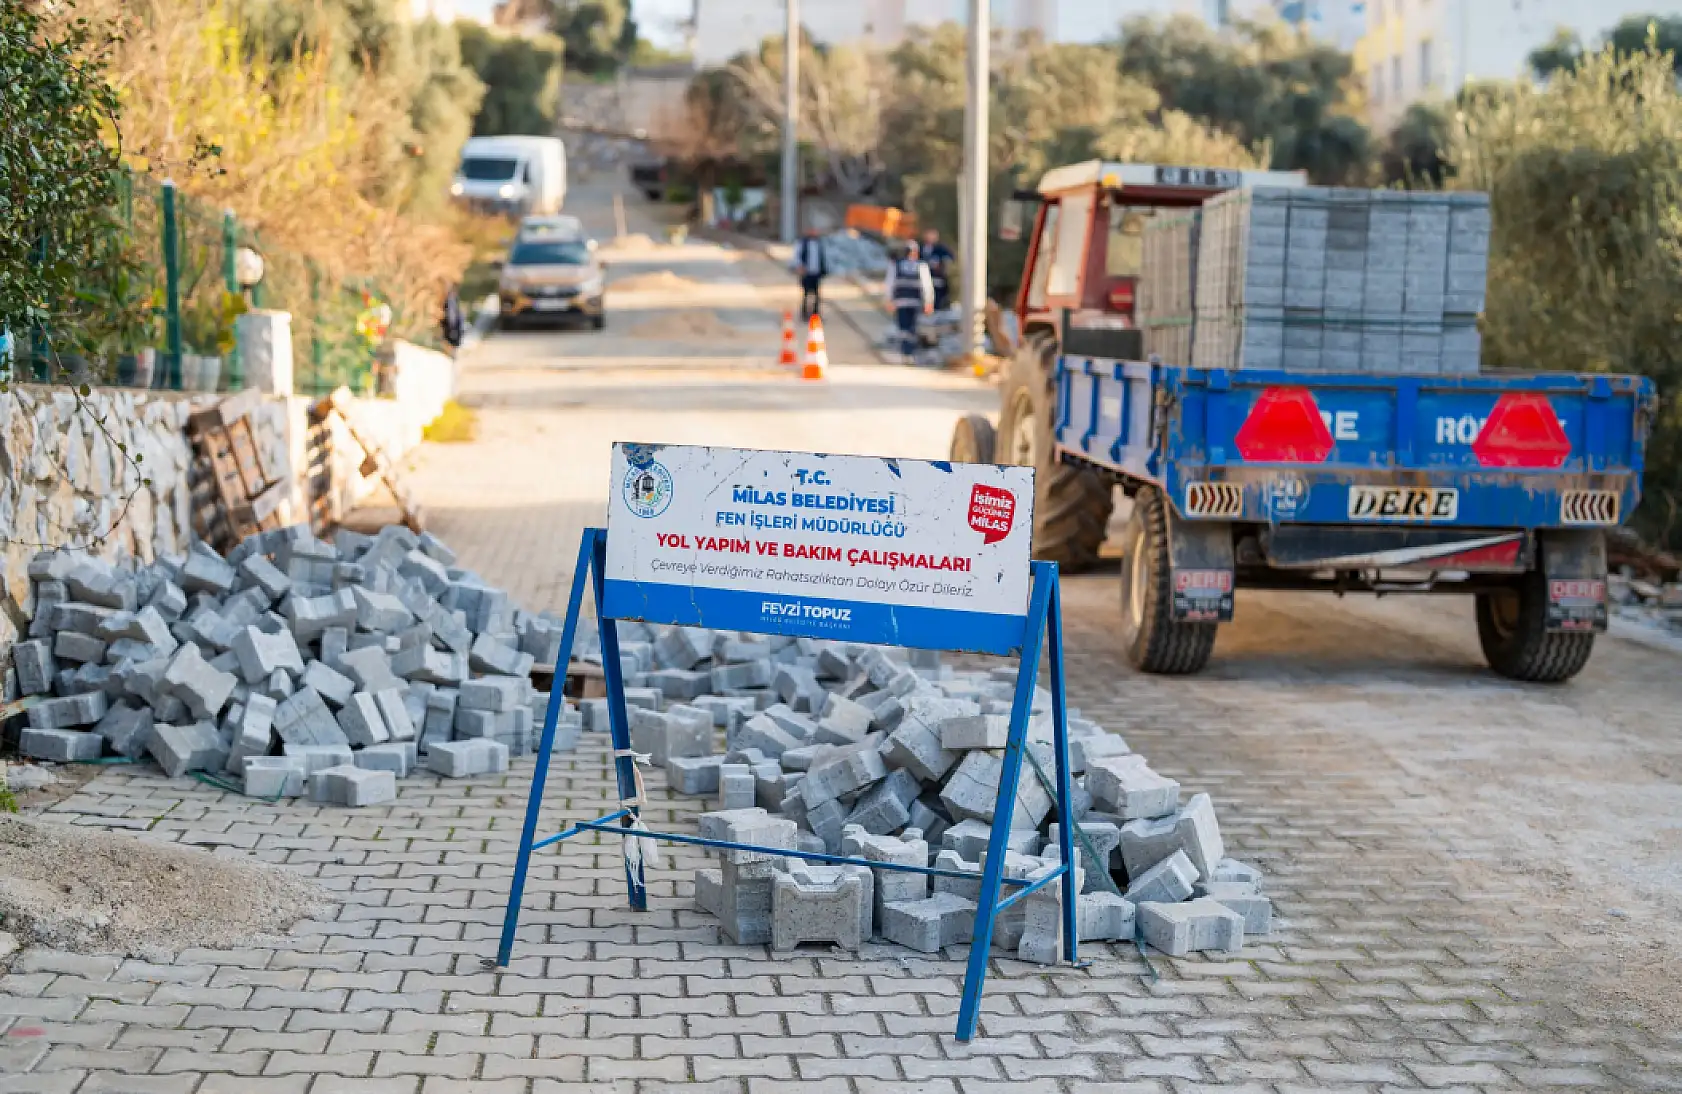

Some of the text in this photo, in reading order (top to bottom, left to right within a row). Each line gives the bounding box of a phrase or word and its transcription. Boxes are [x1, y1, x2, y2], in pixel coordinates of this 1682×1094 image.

[797, 468, 832, 485] T.C.
[732, 487, 894, 514] MİLAS BELEDİYESİ
[1353, 490, 1455, 517] DERE
[716, 510, 905, 538] FEN İŞLERİ MÜDÜRLÜĞÜ
[971, 514, 1009, 532] MİLAS
[656, 532, 972, 572] YOL YAPIM VE BAKIM ÇALIŞMALARI
[651, 558, 697, 575] Çevreye
[700, 563, 764, 580] Verdiğimiz
[766, 568, 854, 587] Rahatsızlıktan
[856, 576, 897, 593] Dolayı
[899, 579, 930, 593] Özür
[761, 600, 852, 621] FEVZİ TOPUZ
